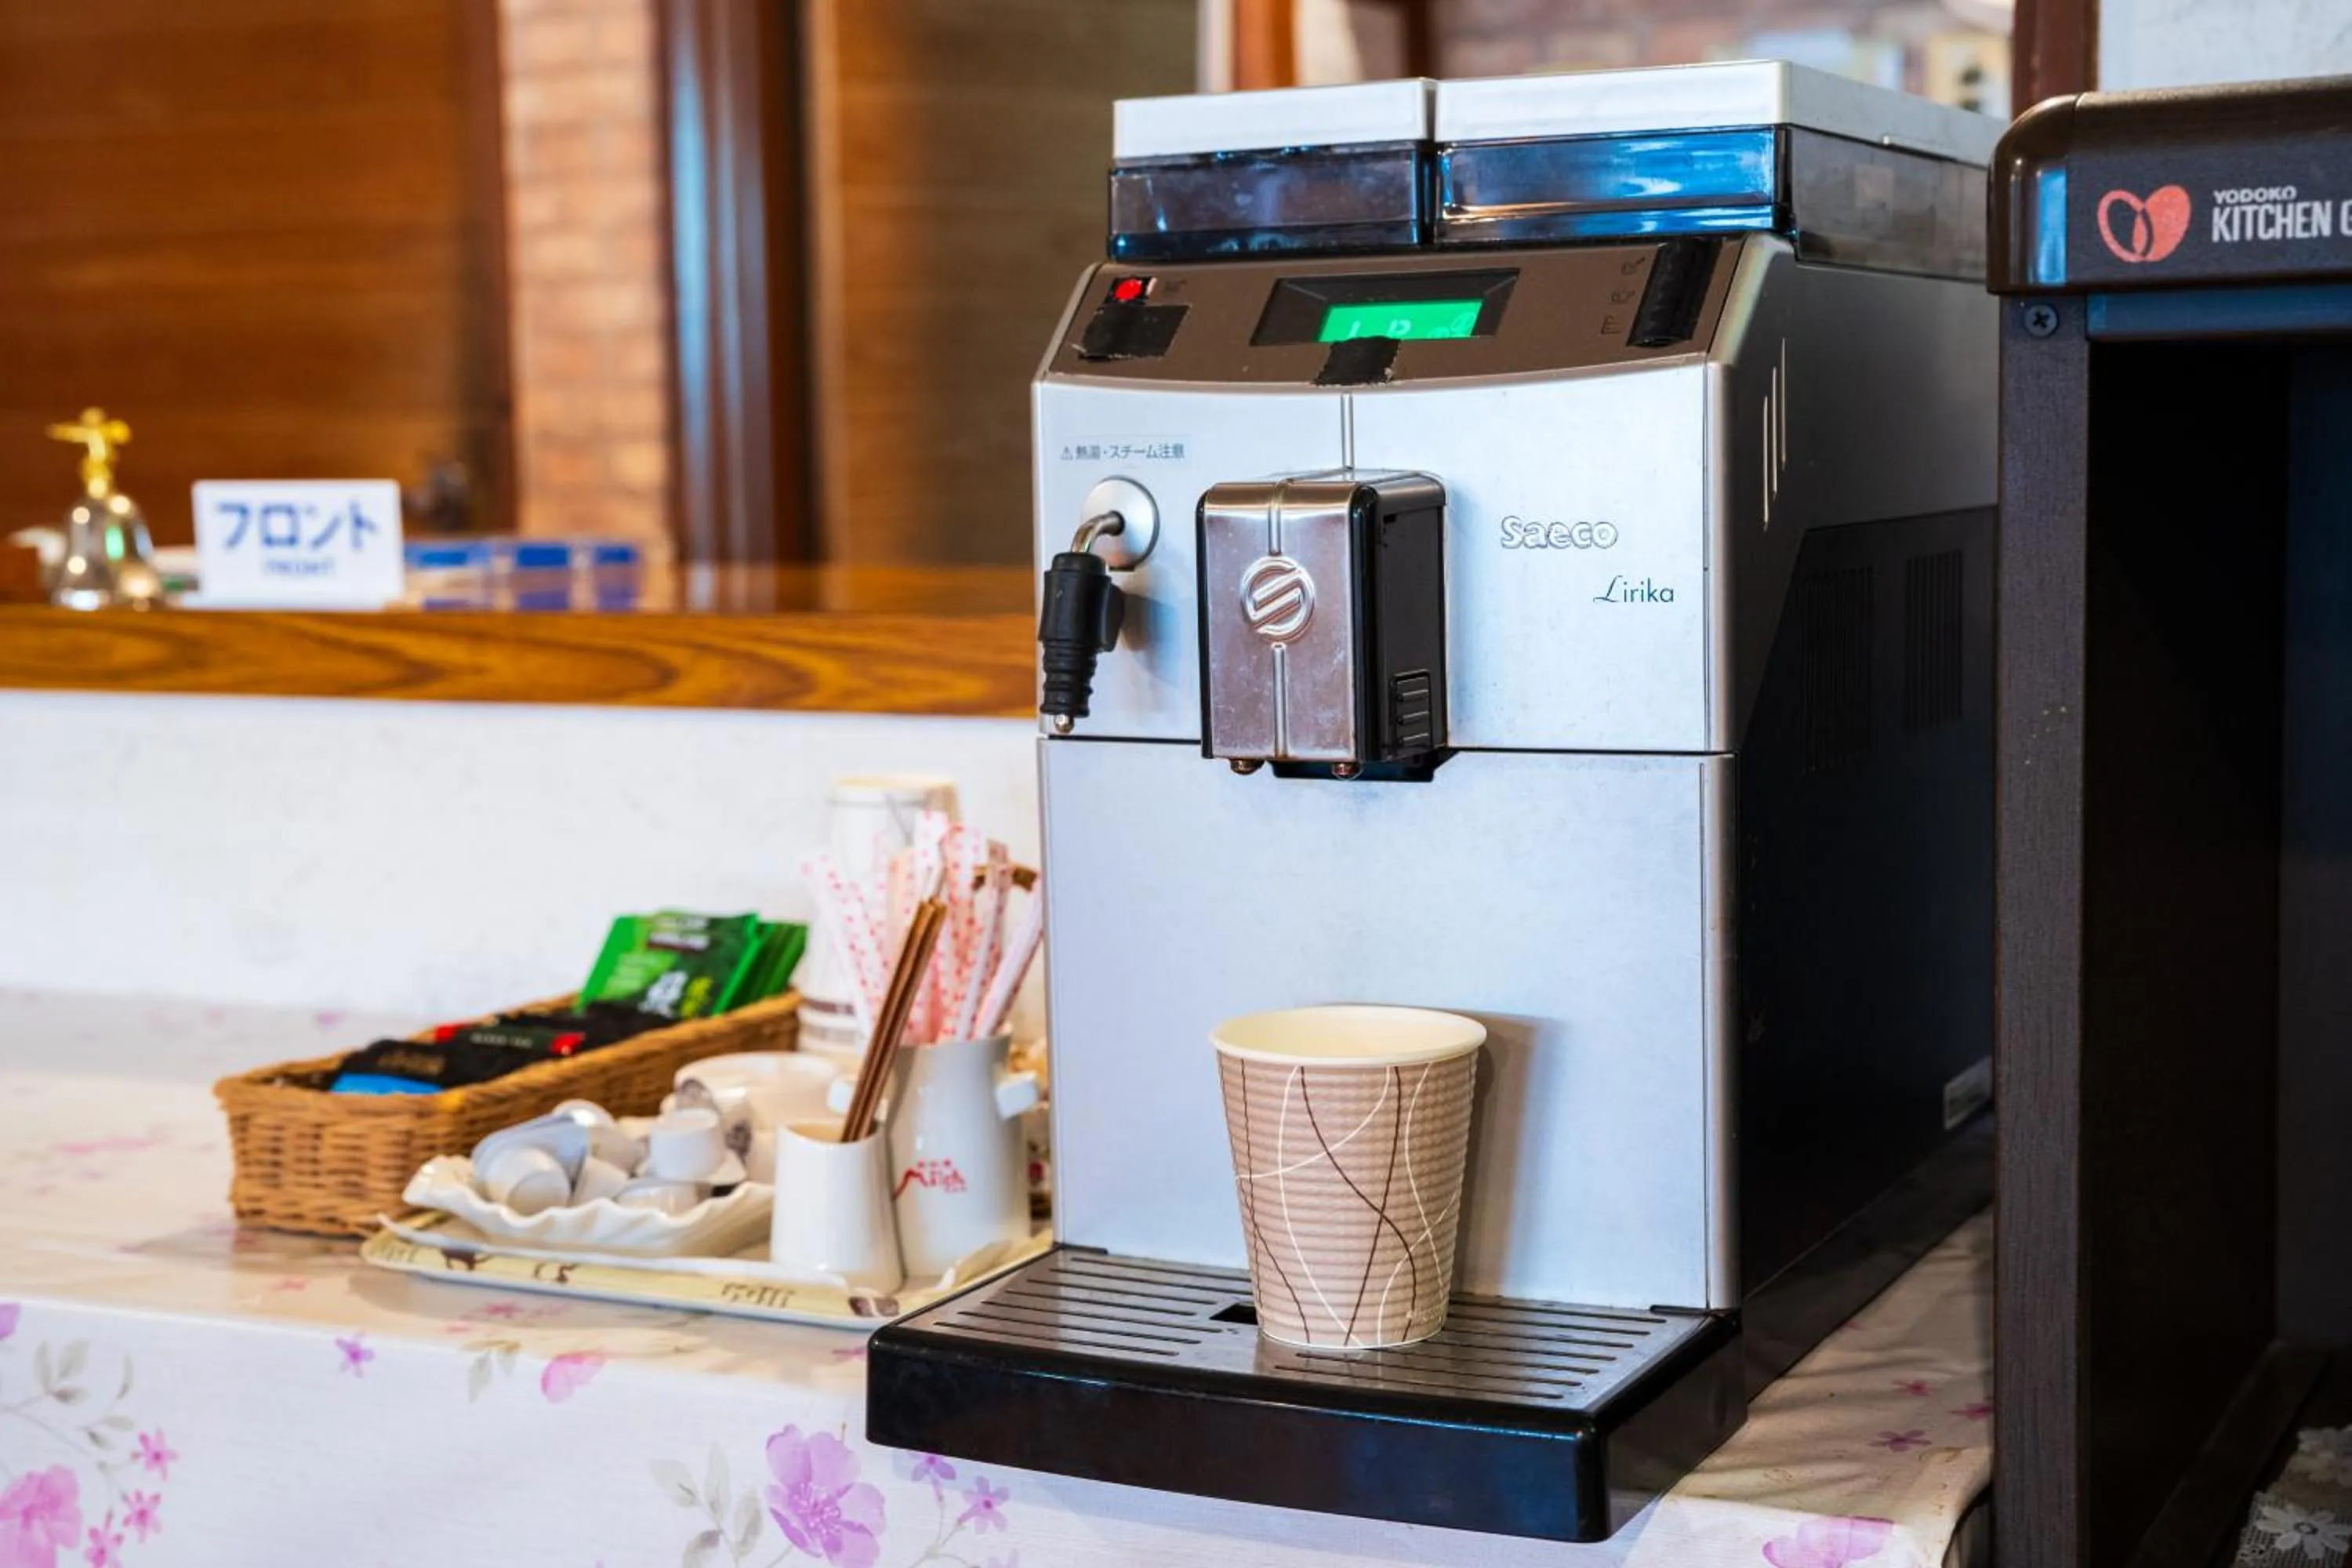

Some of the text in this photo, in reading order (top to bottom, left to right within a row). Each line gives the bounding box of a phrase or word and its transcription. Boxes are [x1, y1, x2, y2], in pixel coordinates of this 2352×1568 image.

[2213, 185, 2297, 204] YODOKO
[2212, 201, 2332, 242] KITCHEN
[218, 498, 377, 550] フロント
[1501, 515, 1619, 550] Saeco
[1592, 574, 1675, 603] Lirika
